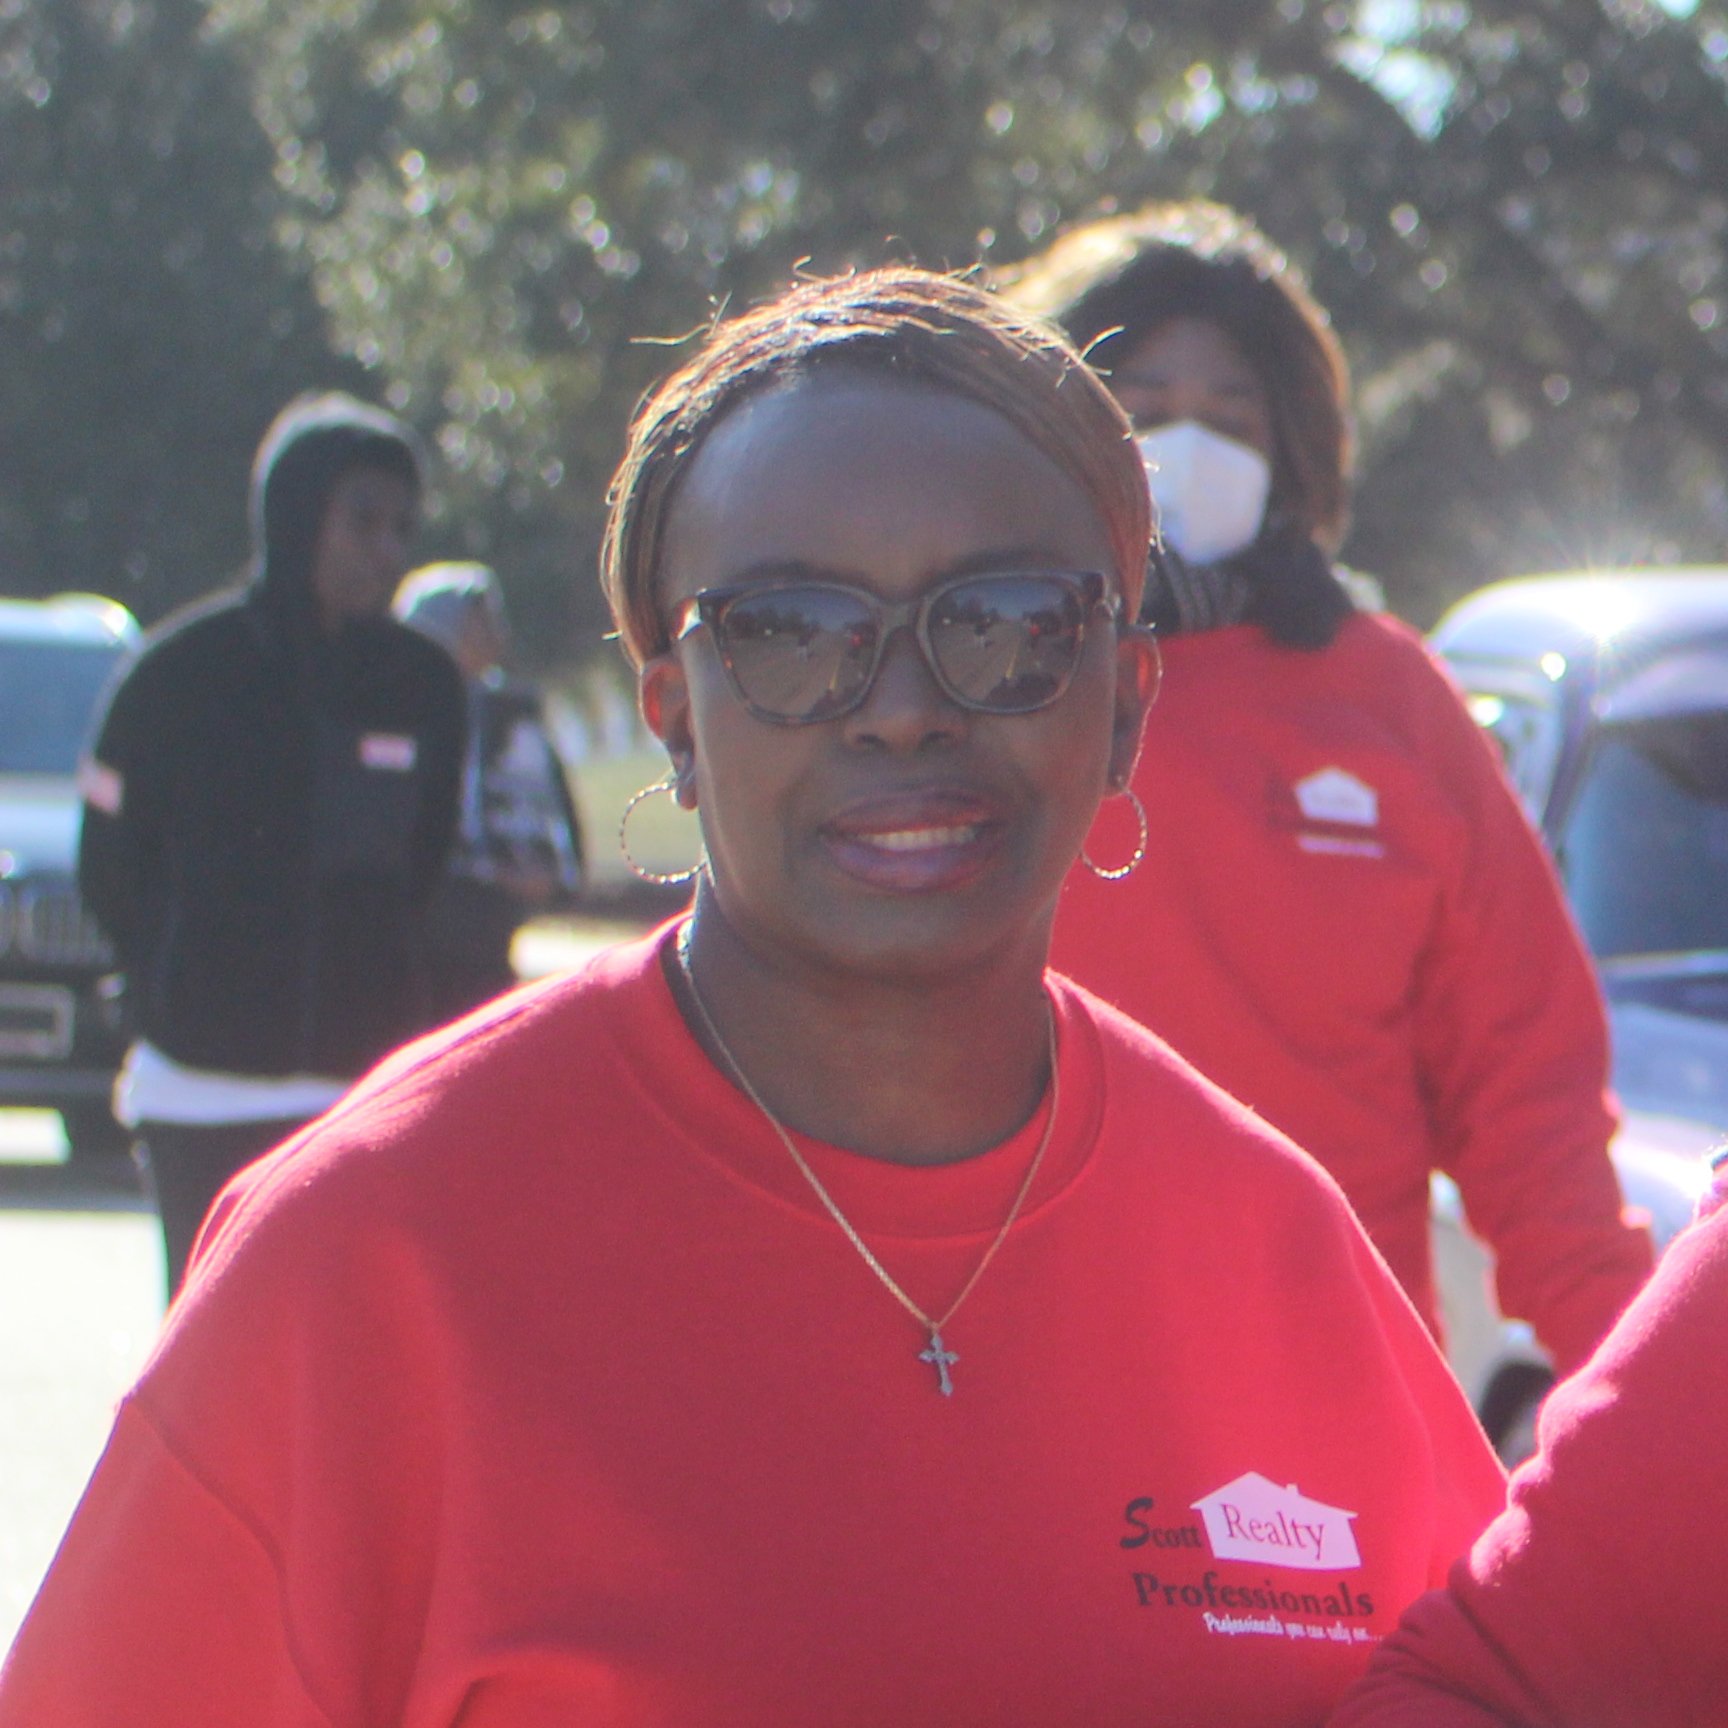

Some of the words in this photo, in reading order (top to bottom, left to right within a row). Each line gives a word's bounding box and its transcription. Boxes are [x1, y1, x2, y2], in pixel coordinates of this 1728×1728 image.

[1119, 1497, 1203, 1549] Scott
[1219, 1503, 1325, 1560] Realty
[1130, 1572, 1375, 1617] Professionals
